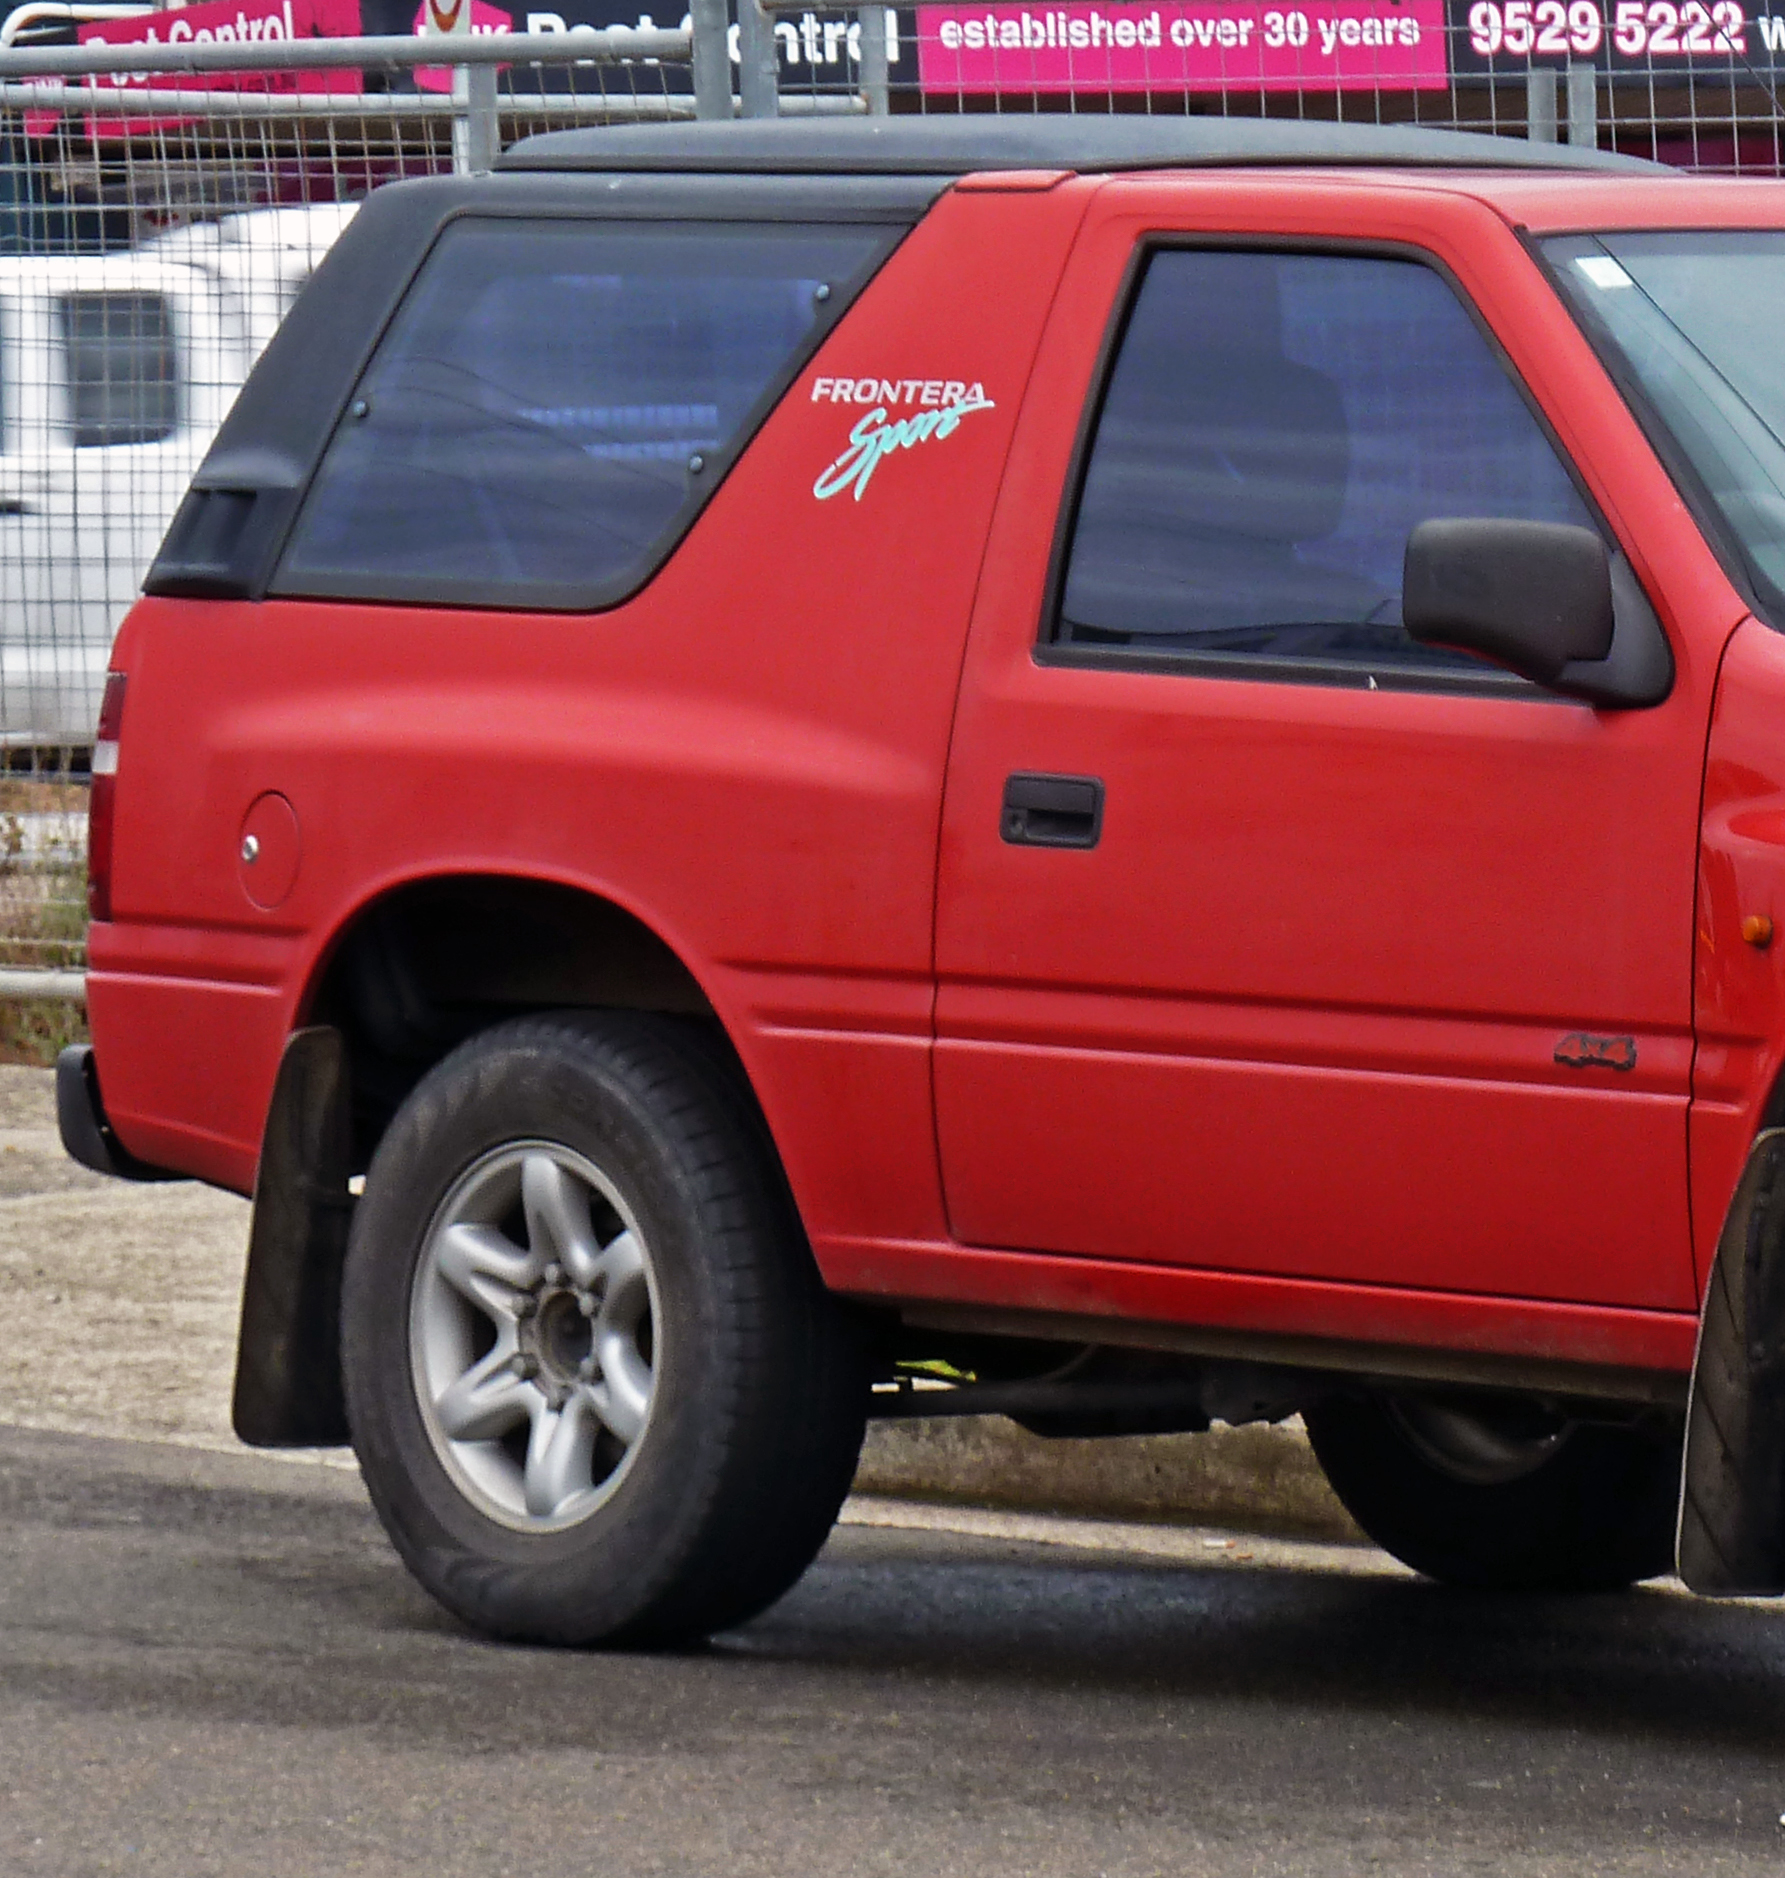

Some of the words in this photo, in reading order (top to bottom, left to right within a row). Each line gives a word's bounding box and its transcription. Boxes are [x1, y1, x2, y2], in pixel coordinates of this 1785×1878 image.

[939, 12, 1162, 48] established
[1170, 18, 1254, 47] over
[1263, 11, 1309, 47] 30
[1317, 17, 1420, 55] years
[1468, 0, 1602, 56] 9529
[1613, 0, 1747, 55] 5222
[811, 377, 985, 405] FRONTERA
[813, 399, 995, 501] Sport
